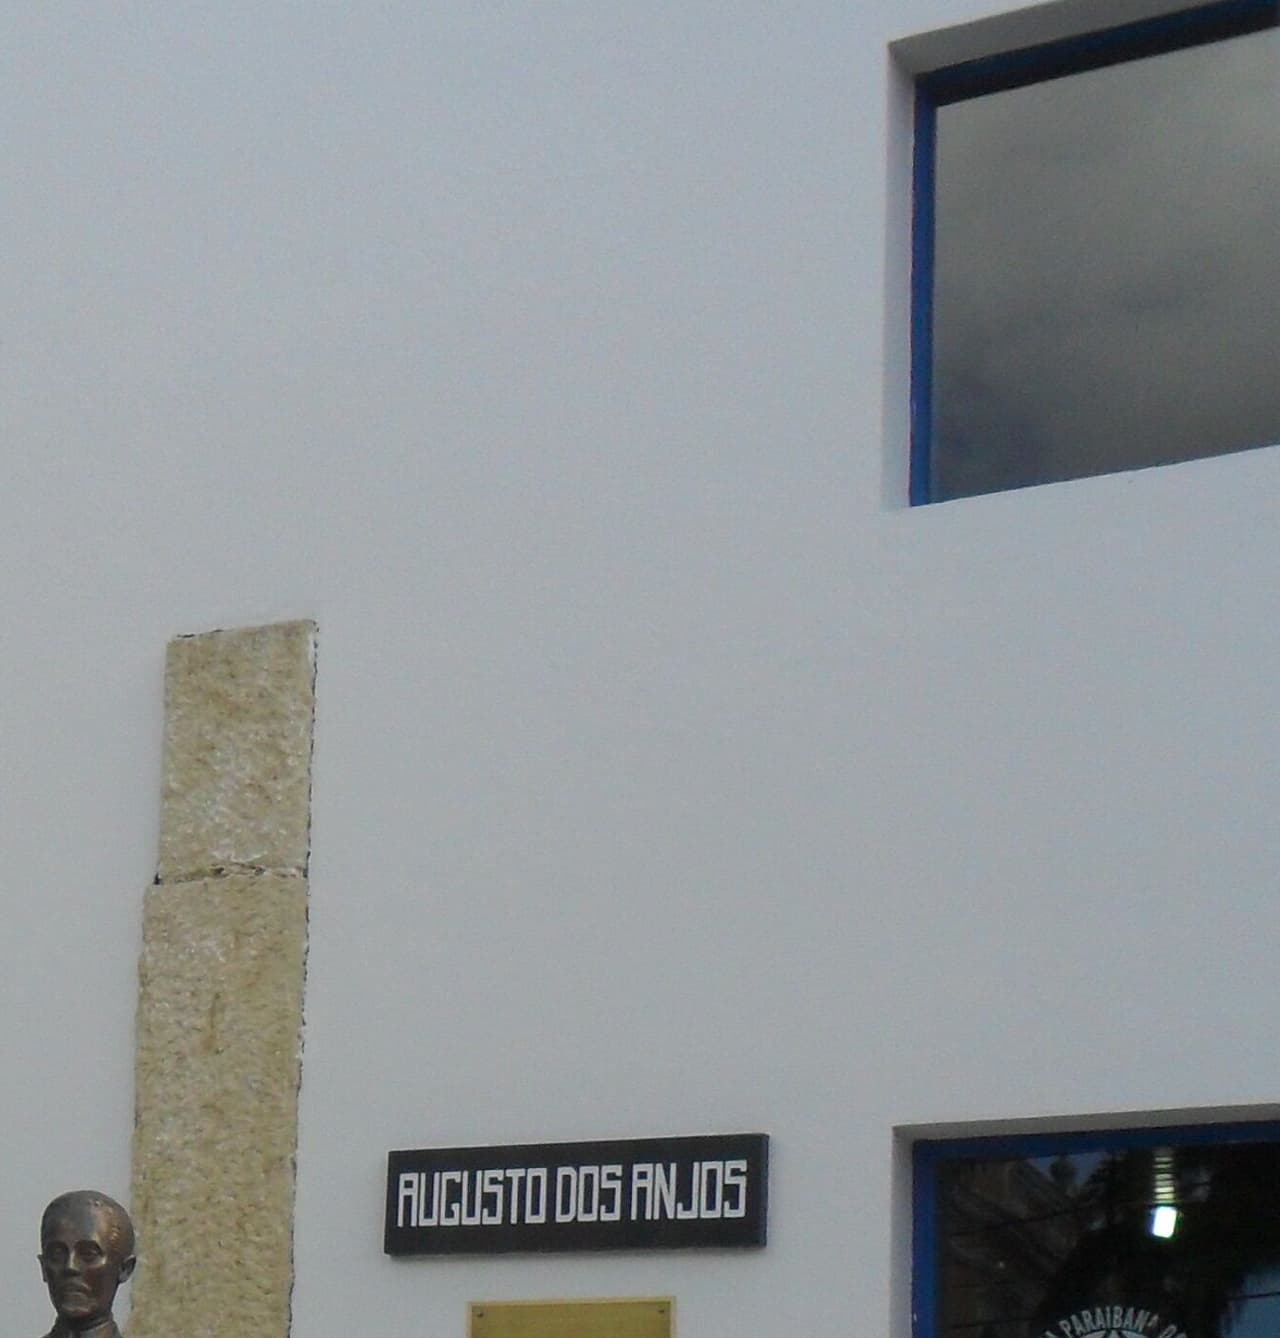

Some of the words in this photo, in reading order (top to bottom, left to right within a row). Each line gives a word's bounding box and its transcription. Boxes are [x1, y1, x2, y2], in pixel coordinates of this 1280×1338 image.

[397, 1167, 548, 1227] AUGUSTO
[556, 1165, 622, 1223] DOS
[631, 1160, 747, 1221] ANJOS
